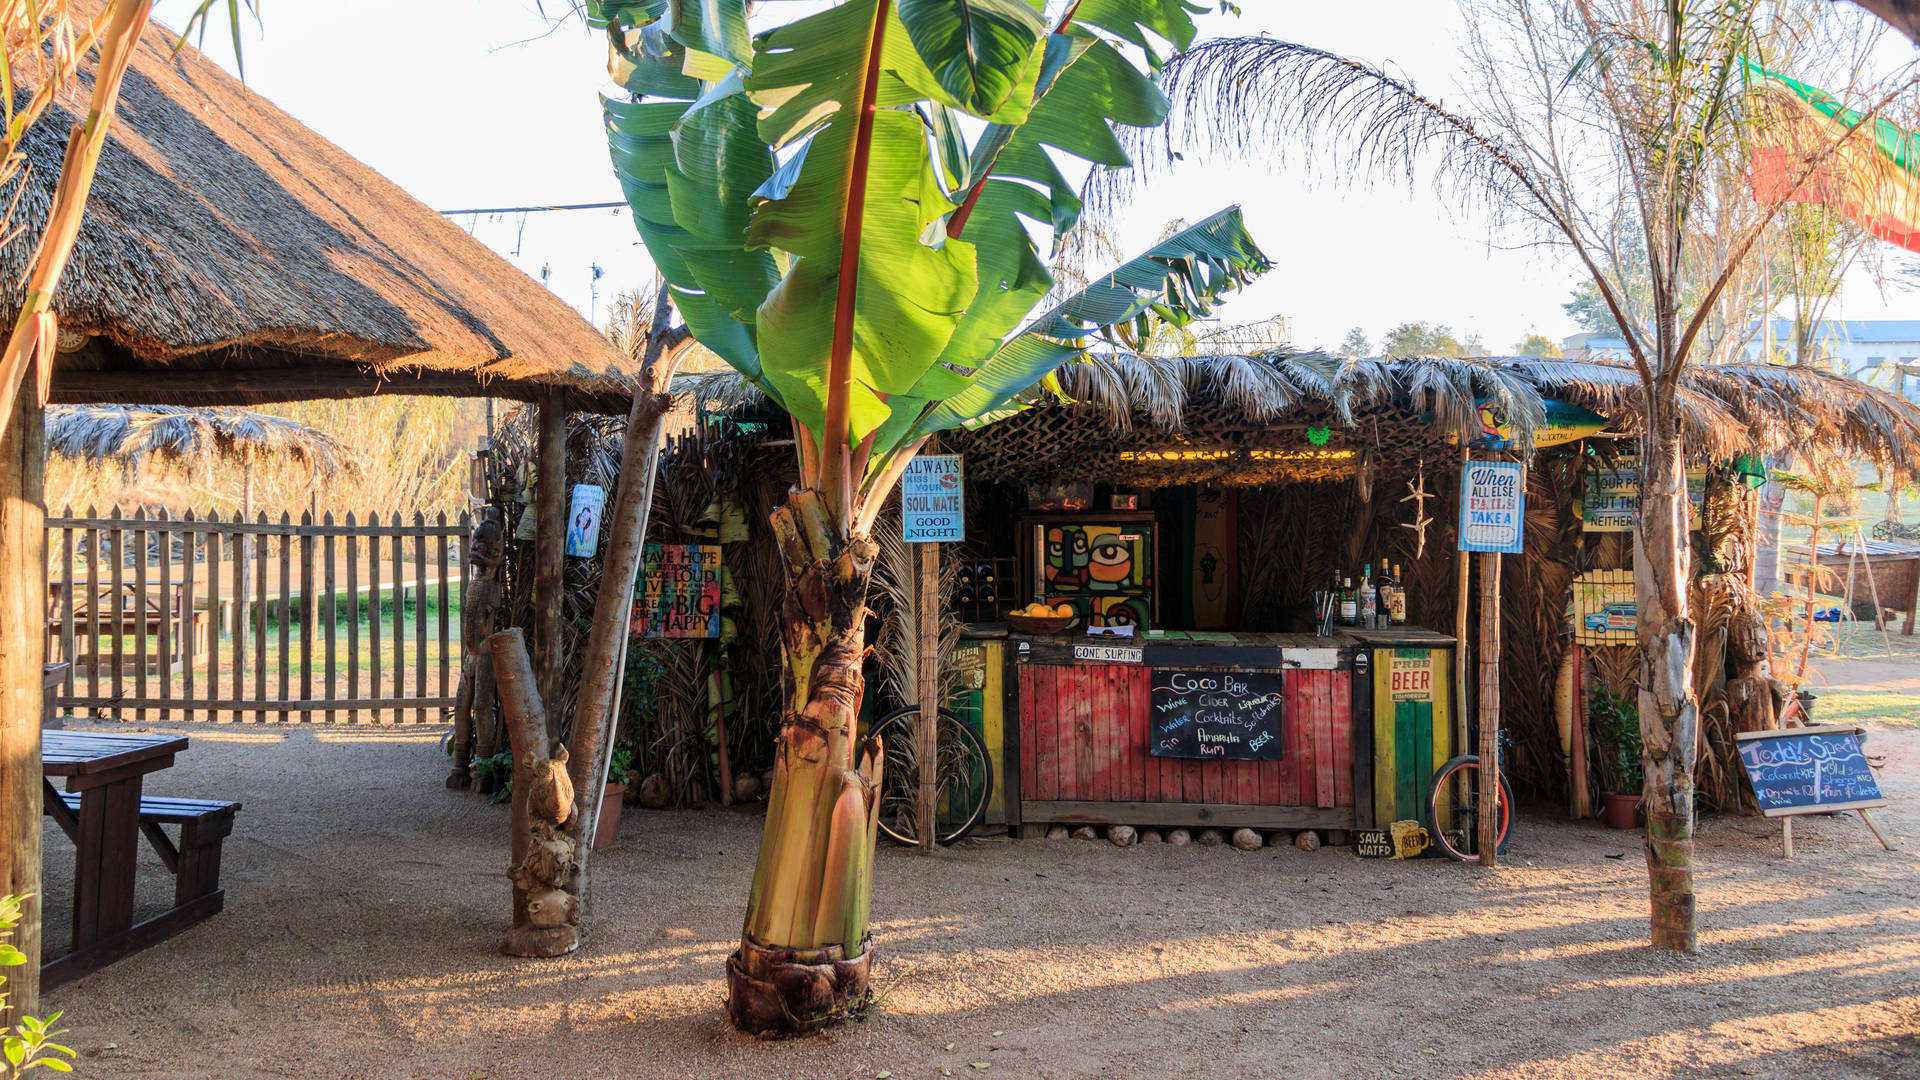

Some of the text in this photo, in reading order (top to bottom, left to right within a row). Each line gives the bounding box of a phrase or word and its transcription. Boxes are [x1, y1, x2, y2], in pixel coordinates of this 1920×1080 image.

[905, 460, 960, 474] ALWAYS
[906, 475, 929, 483] KISS
[1471, 468, 1516, 487] When
[1596, 478, 1624, 489] OUR
[1471, 486, 1514, 498] ALL ELSE
[906, 496, 960, 512] SOUL MATE
[1470, 498, 1515, 510] FAILS
[1593, 496, 1616, 508] BUT
[915, 517, 951, 527] GOOD
[1471, 512, 1512, 524] TAKE A
[1590, 516, 1633, 527] NEITHER
[909, 528, 958, 537] NIGHT
[680, 551, 717, 564] HOPE
[674, 570, 716, 583] LOUD
[675, 594, 714, 616] BIG
[651, 612, 712, 633] HAPPY
[1075, 647, 1142, 661] GONE SURFING
[1393, 659, 1431, 669] FREE
[1391, 671, 1430, 690] BEER
[1359, 832, 1387, 844] SAVE
[1403, 834, 1421, 849] BEER
[1358, 845, 1392, 857] WATER
